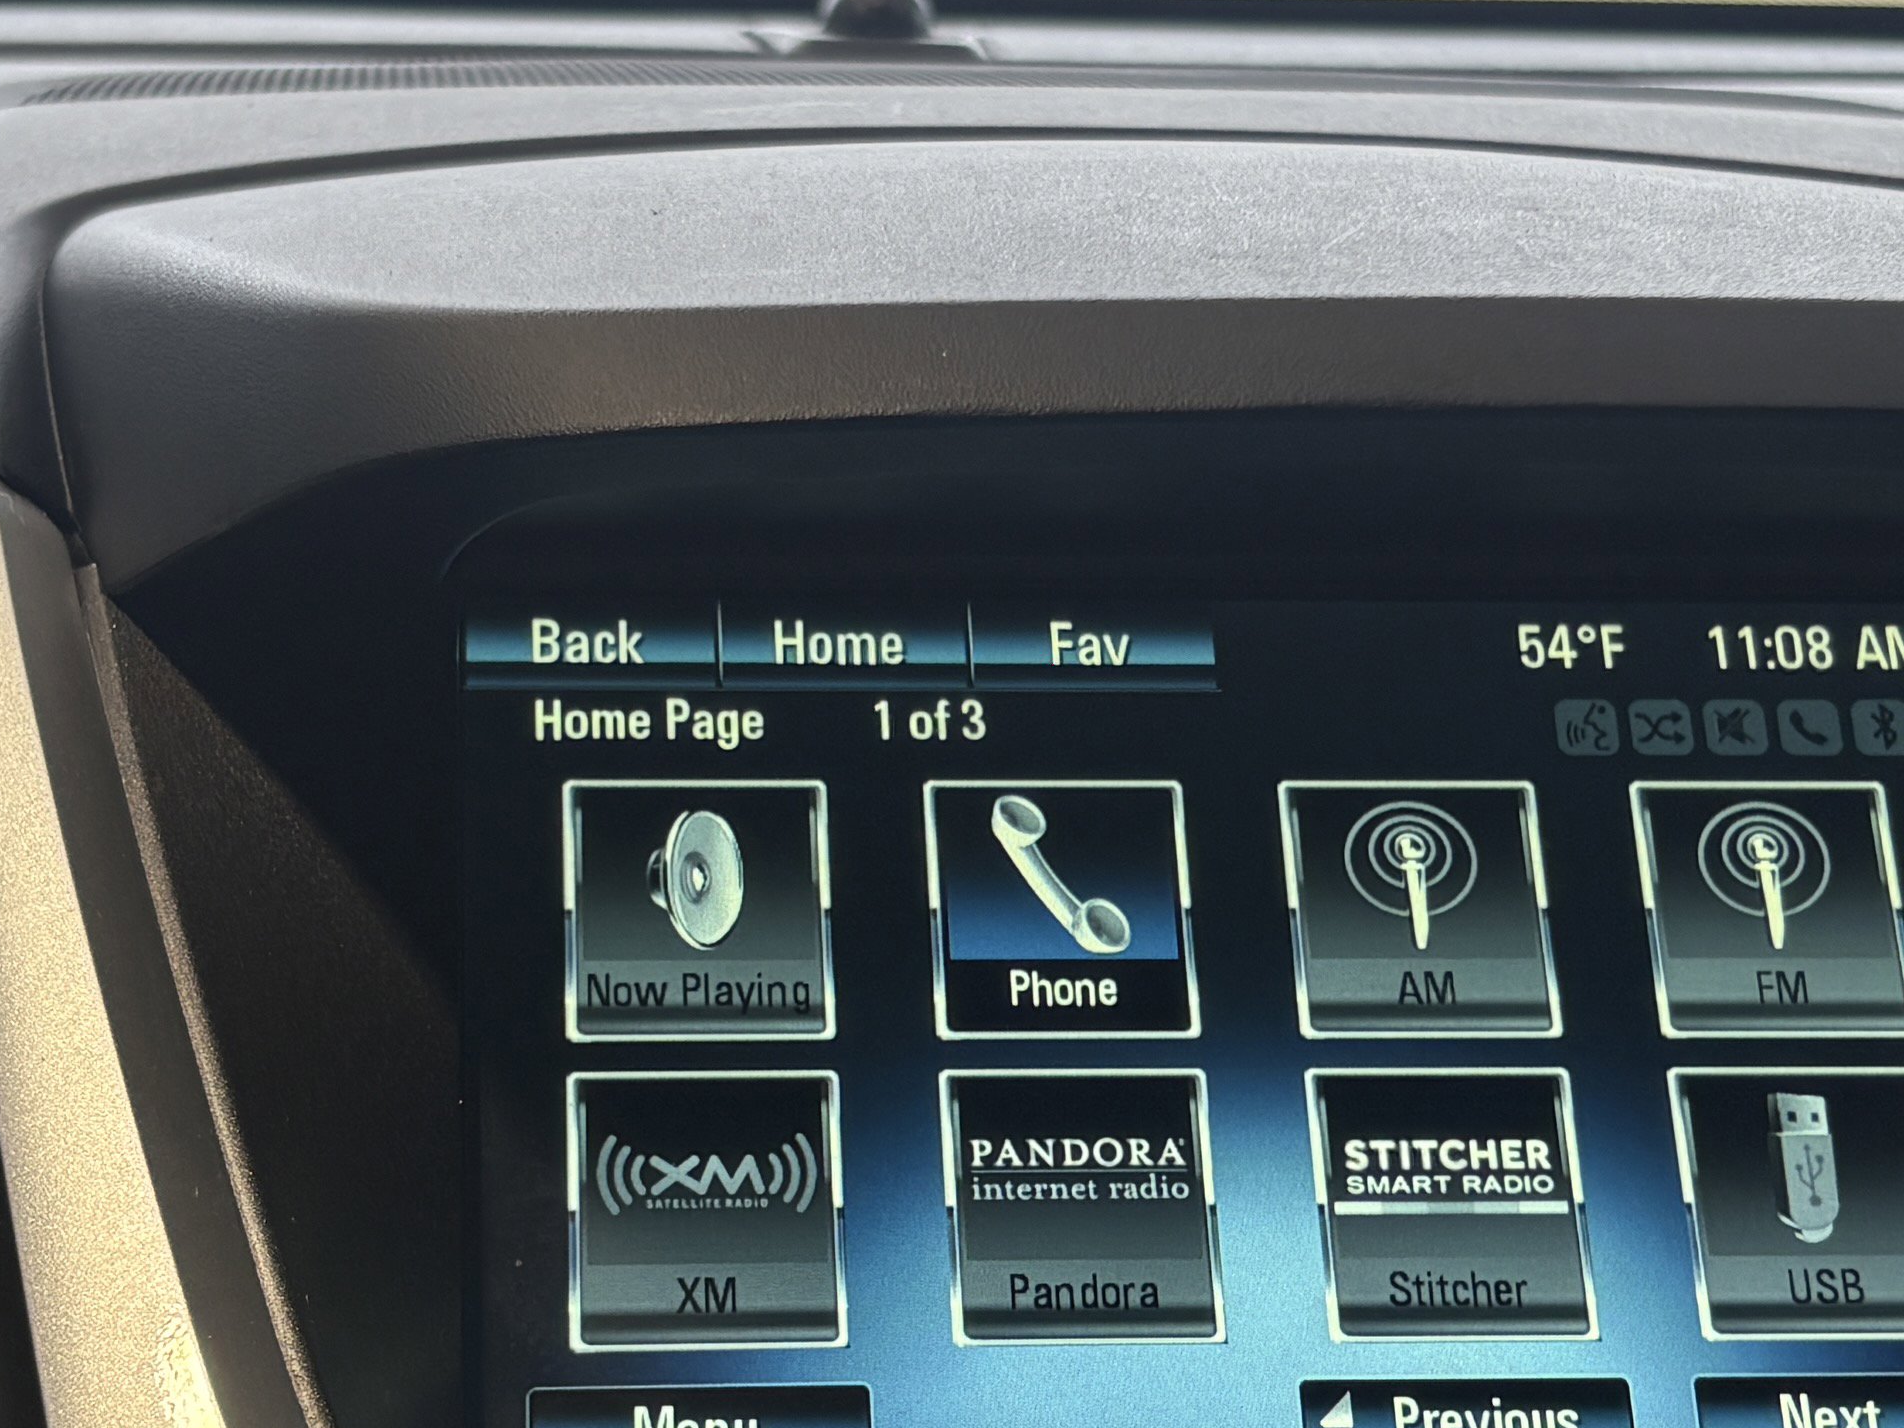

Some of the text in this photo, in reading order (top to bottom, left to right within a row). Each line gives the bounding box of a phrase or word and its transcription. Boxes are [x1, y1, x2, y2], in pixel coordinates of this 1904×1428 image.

[531, 619, 1130, 666] Back Home Fav
[1517, 623, 1625, 670] 54°F
[1708, 625, 1834, 671] 11:08
[535, 700, 987, 750] Home Page 1 of 3
[587, 973, 811, 1015] Now Playing
[1009, 971, 1118, 1008] Phone
[1397, 970, 1457, 1005] AM
[1756, 970, 1809, 1005] FM
[969, 1137, 1187, 1168] PANDORA
[1344, 1138, 1552, 1171] STITCHER
[649, 1154, 766, 1195] XM
[972, 1173, 1190, 1200] internet radio
[1346, 1174, 1555, 1194] SMART RADIO
[676, 1277, 737, 1313] XM
[1010, 1273, 1159, 1310] Pandora
[1389, 1271, 1527, 1309] Stitcher
[1787, 1268, 1865, 1305] USB
